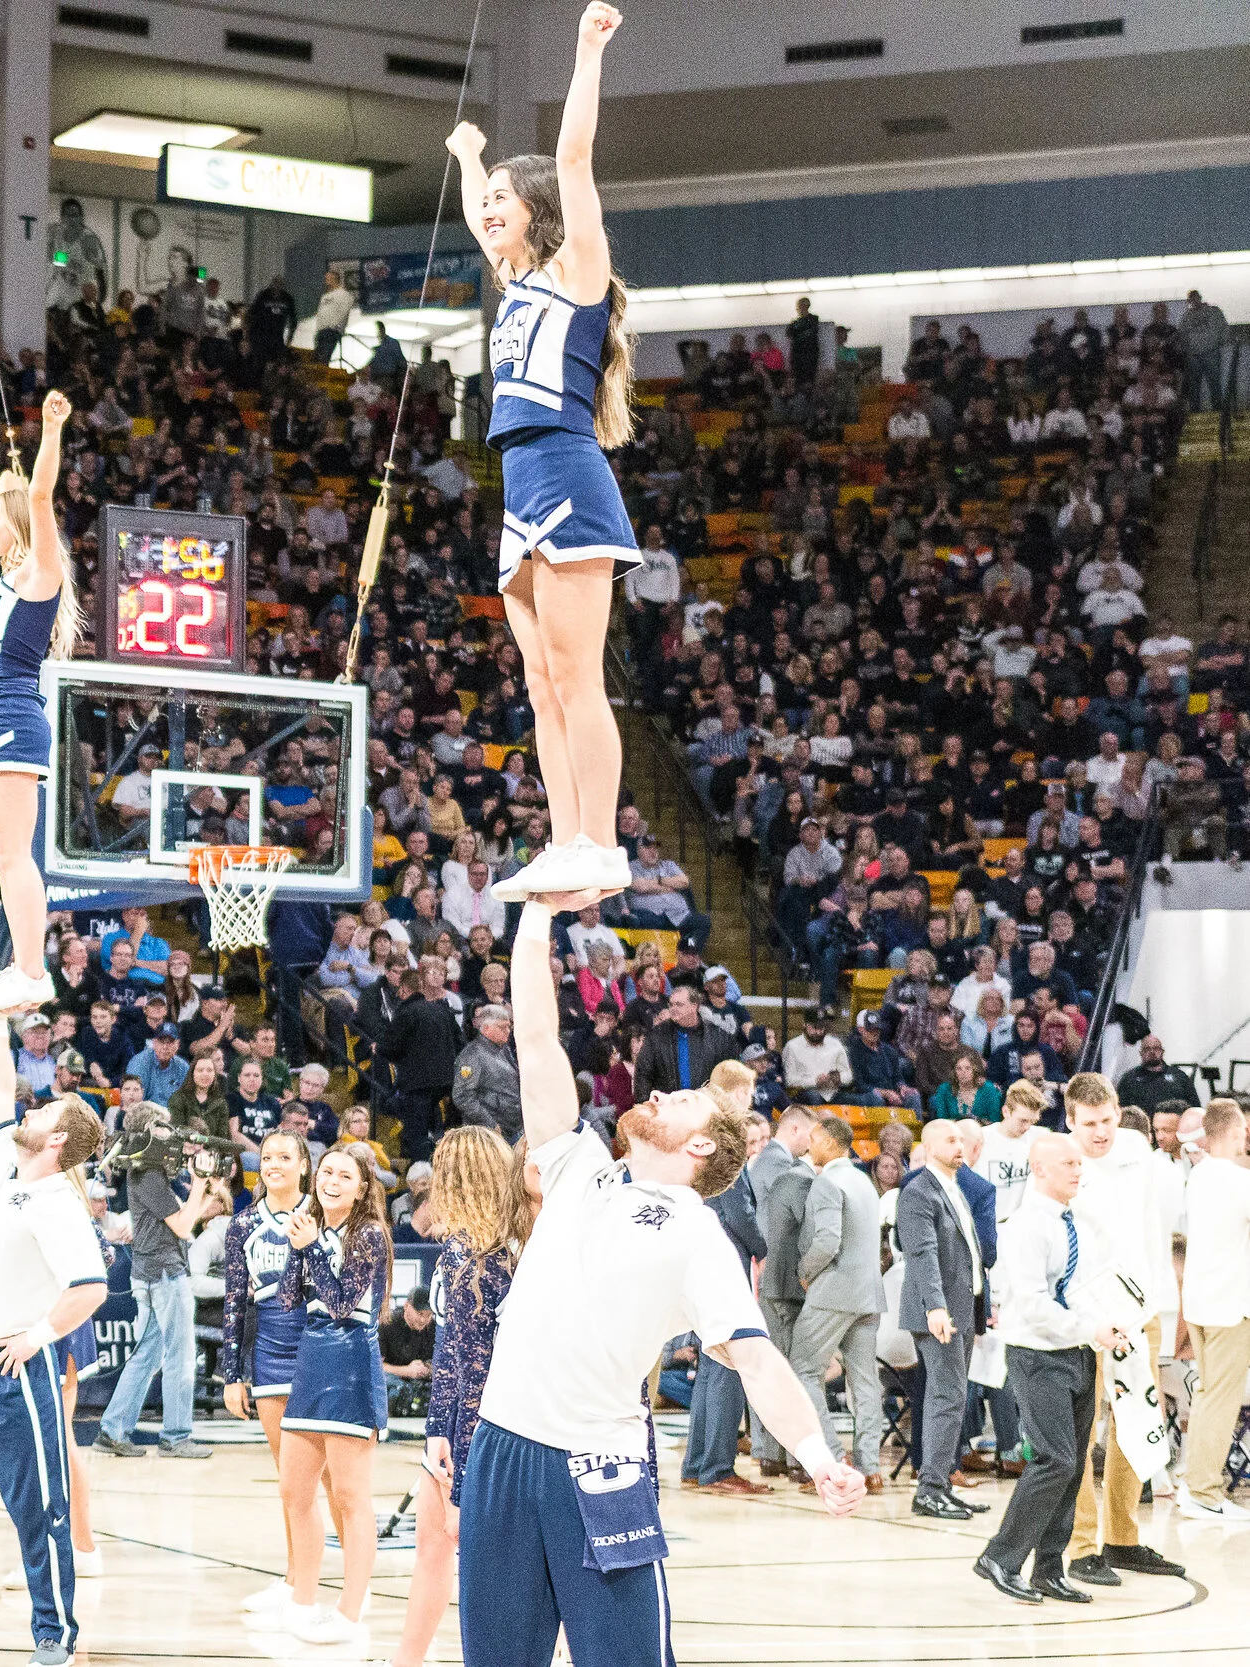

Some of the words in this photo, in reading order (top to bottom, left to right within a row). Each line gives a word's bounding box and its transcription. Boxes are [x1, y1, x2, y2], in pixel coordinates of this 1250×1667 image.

[19, 215, 37, 240] T
[136, 579, 212, 656] 22
[57, 863, 88, 871] SPALDING
[592, 1533, 626, 1547] ZIONS
[627, 1526, 659, 1542] BANK
